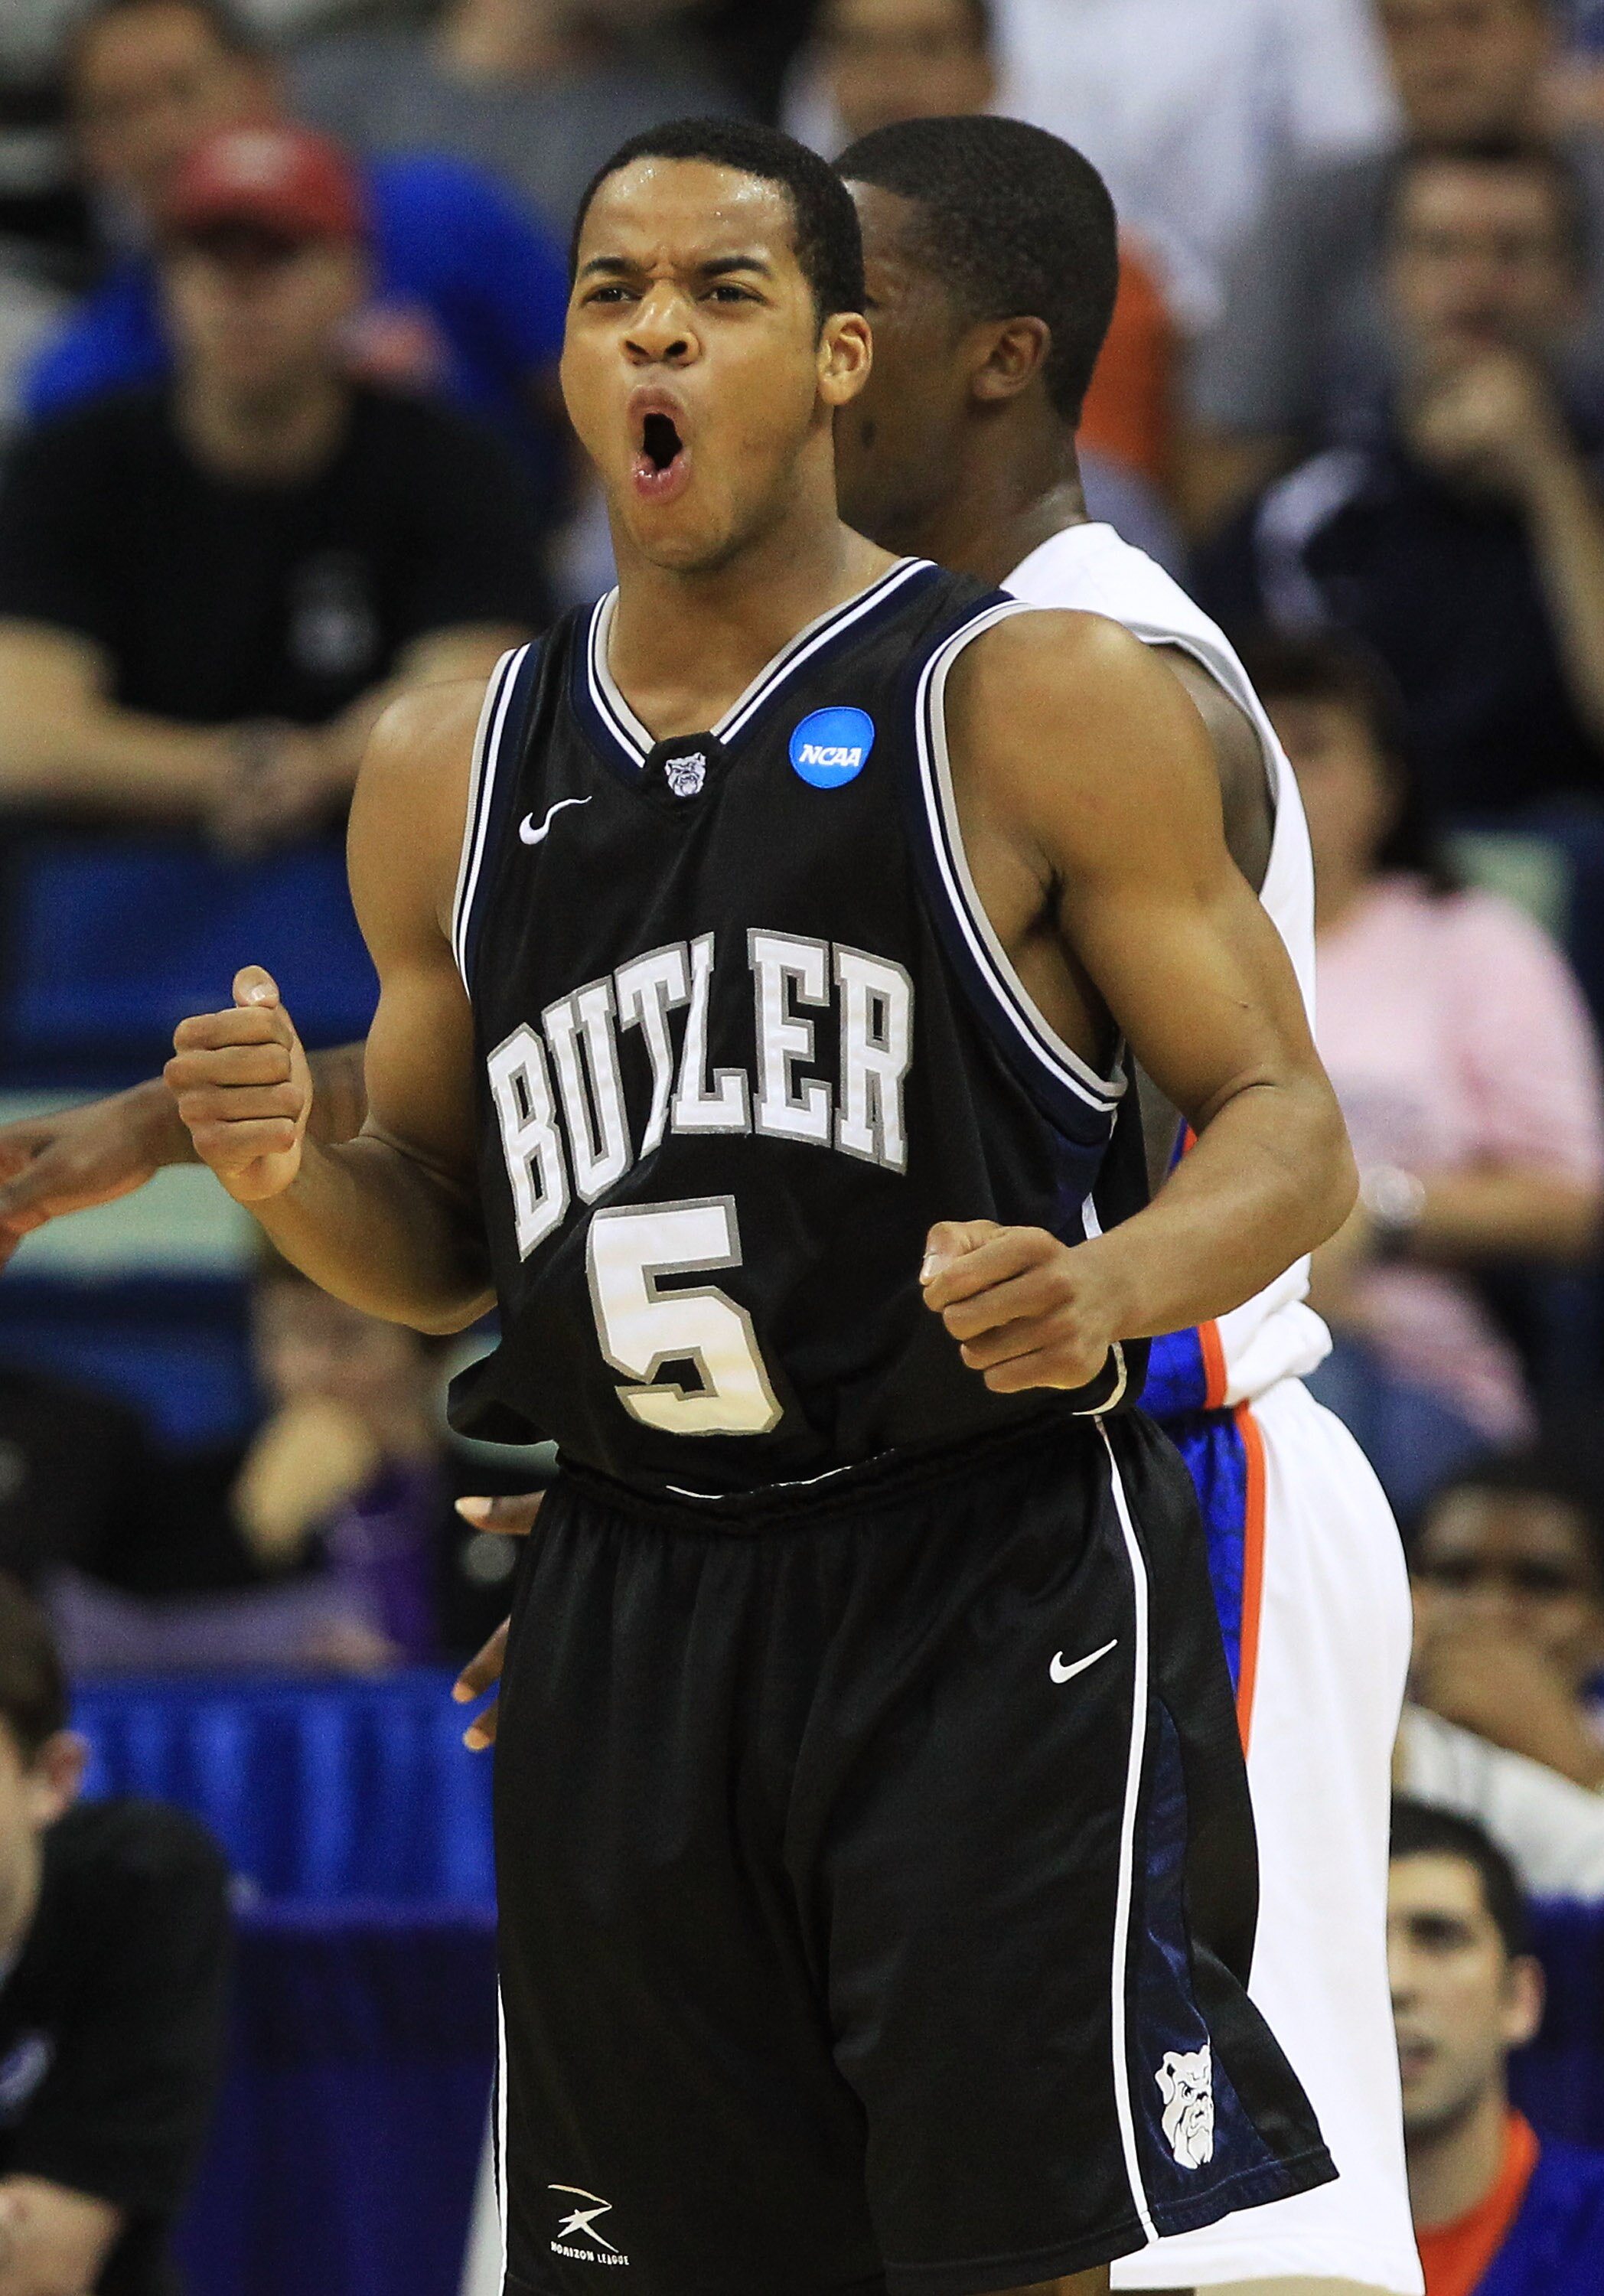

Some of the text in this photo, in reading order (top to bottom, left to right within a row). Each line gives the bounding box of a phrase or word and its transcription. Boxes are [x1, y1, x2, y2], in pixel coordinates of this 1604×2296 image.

[798, 744, 862, 767] NCAA
[487, 928, 914, 1262] BUTLER
[585, 1195, 784, 1436] 5
[550, 2241, 630, 2265] HORIZON LEAGUE
